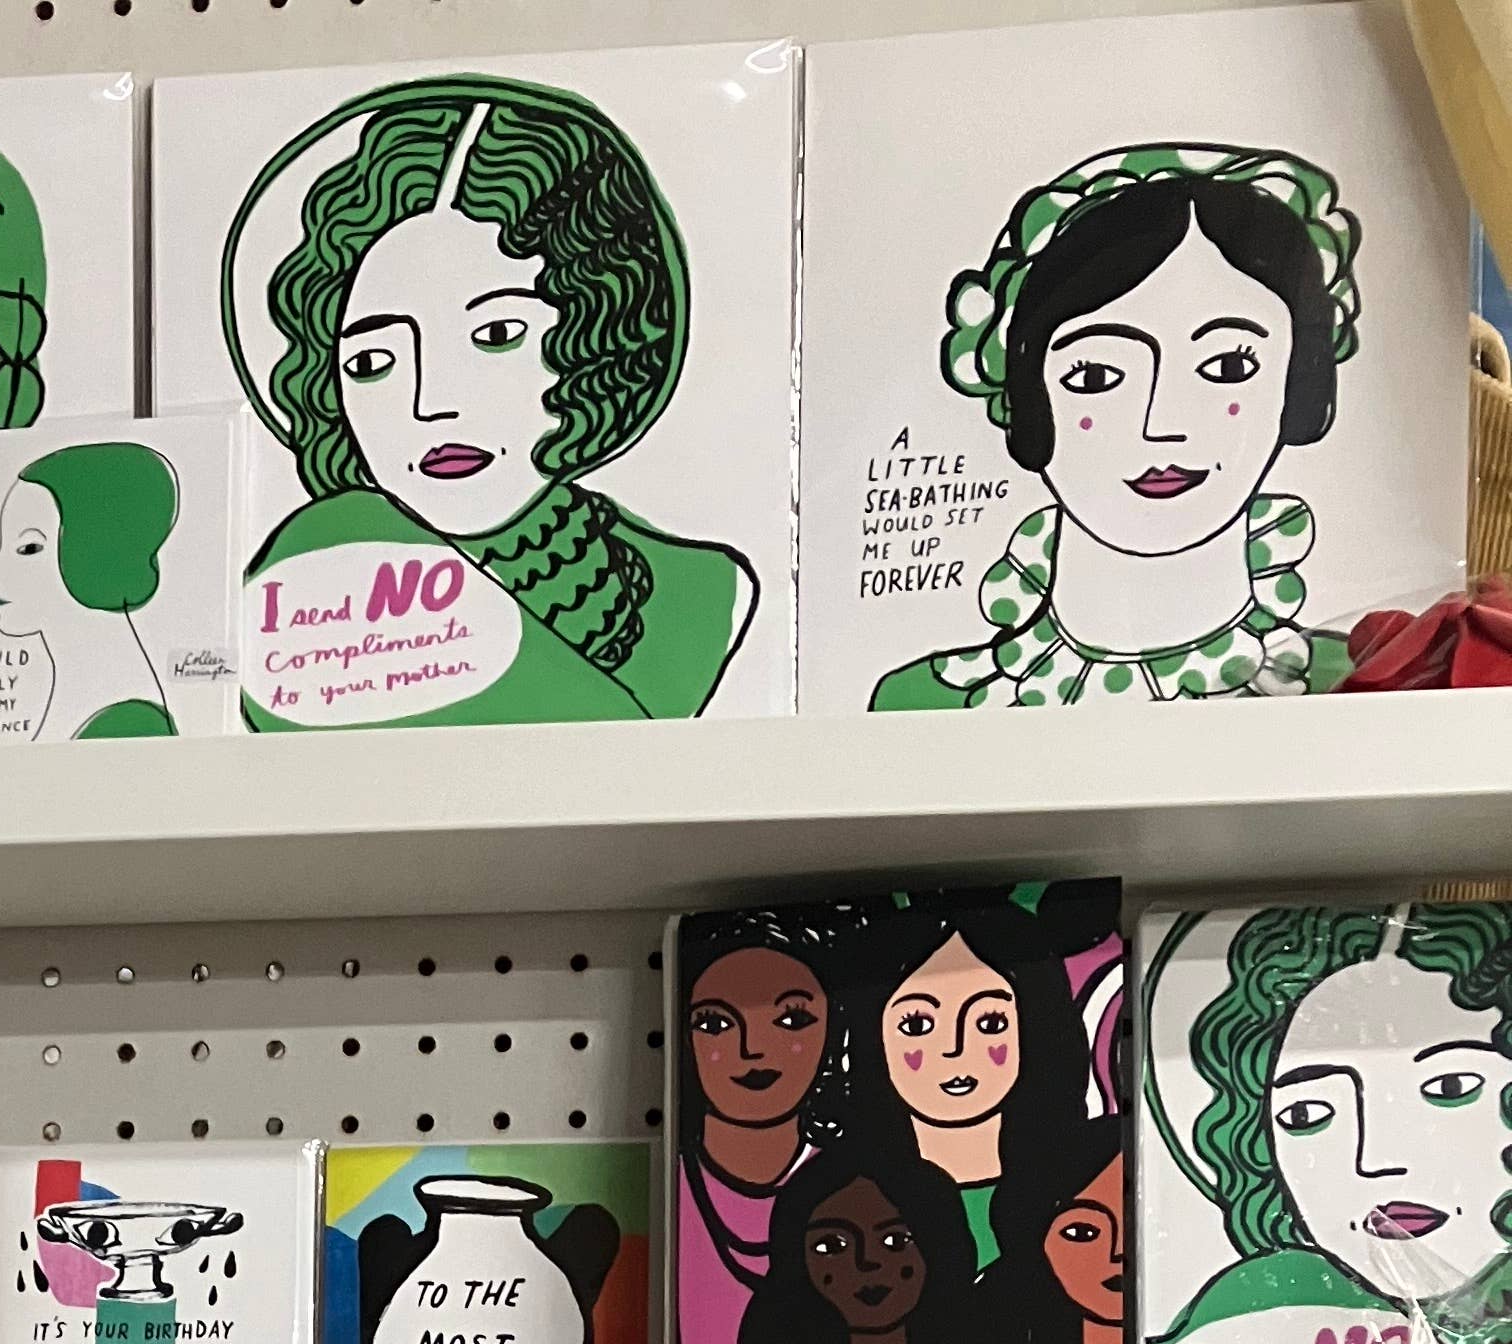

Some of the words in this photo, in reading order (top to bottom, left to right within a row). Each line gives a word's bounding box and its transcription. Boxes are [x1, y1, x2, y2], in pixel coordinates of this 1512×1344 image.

[890, 425, 910, 451] A
[867, 454, 966, 482] LITTLE
[862, 513, 934, 536] WOULD
[944, 506, 985, 527] SET
[862, 542, 892, 561] ME
[910, 536, 941, 558] UP
[859, 560, 965, 599] FOREVER
[259, 580, 284, 633] I
[289, 594, 352, 628] send
[365, 559, 466, 623] NO
[270, 684, 301, 710] to
[319, 678, 378, 706] your
[385, 660, 477, 692] mother
[417, 1280, 449, 1310] TO
[463, 1277, 527, 1309] THE
[33, 1316, 68, 1341] IT'S
[82, 1319, 129, 1341] YOUR
[144, 1319, 235, 1341] BIRTHDAY
